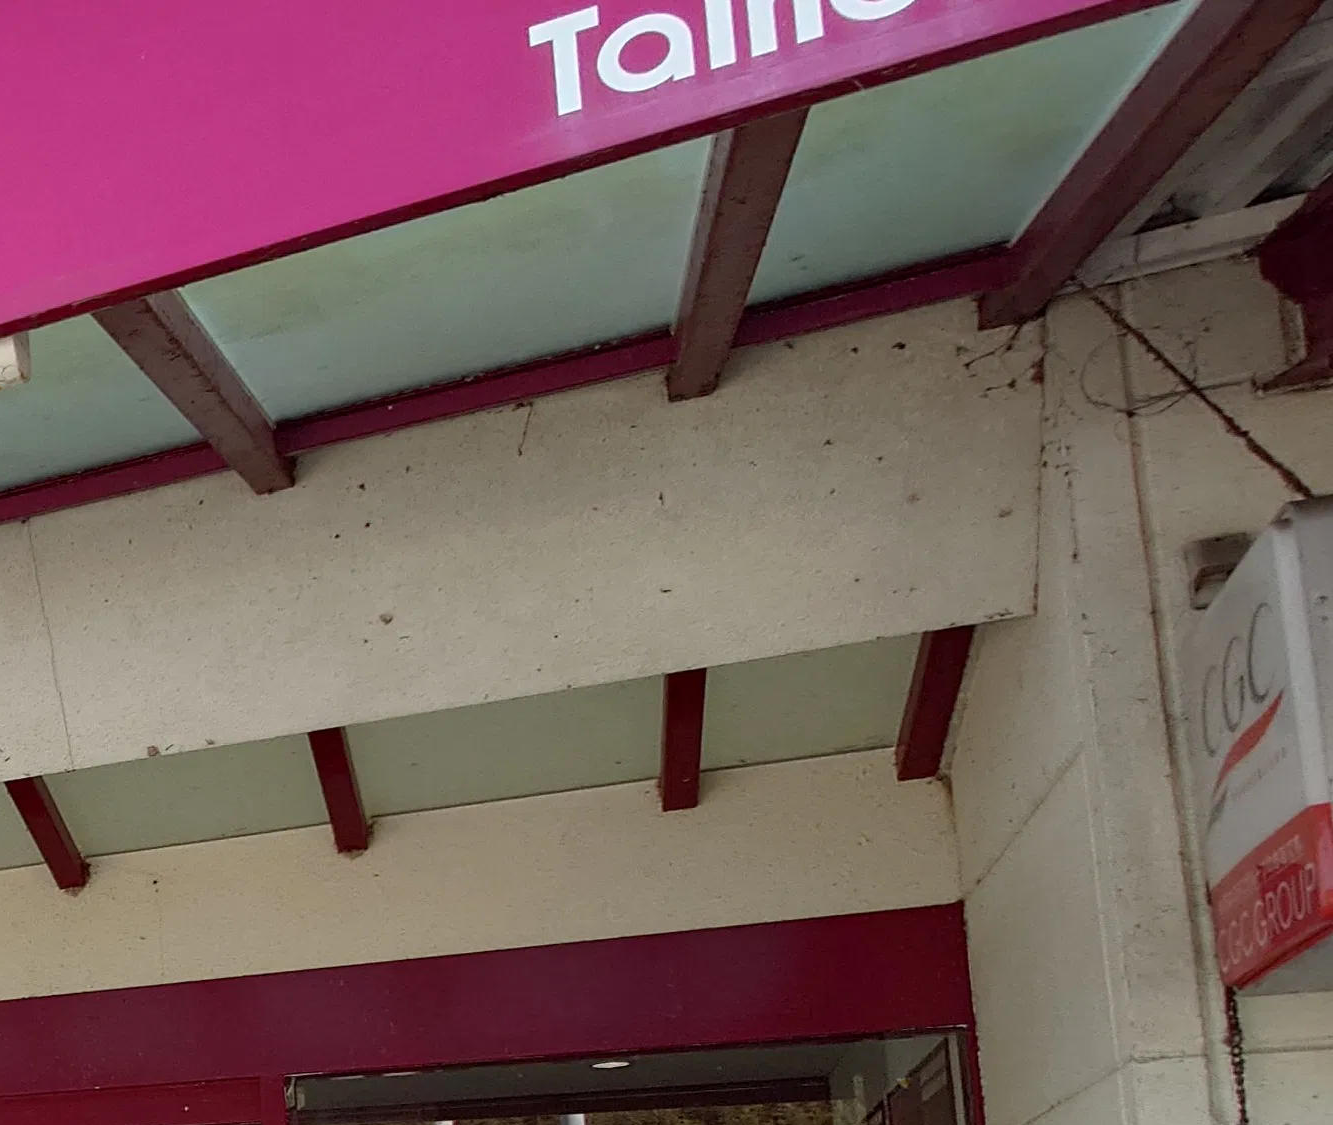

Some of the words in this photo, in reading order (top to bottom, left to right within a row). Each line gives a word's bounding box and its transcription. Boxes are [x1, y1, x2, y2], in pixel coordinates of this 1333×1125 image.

[528, 0, 917, 116] Tai
[1201, 602, 1275, 757] CGC
[1253, 862, 1315, 946] GROUP
